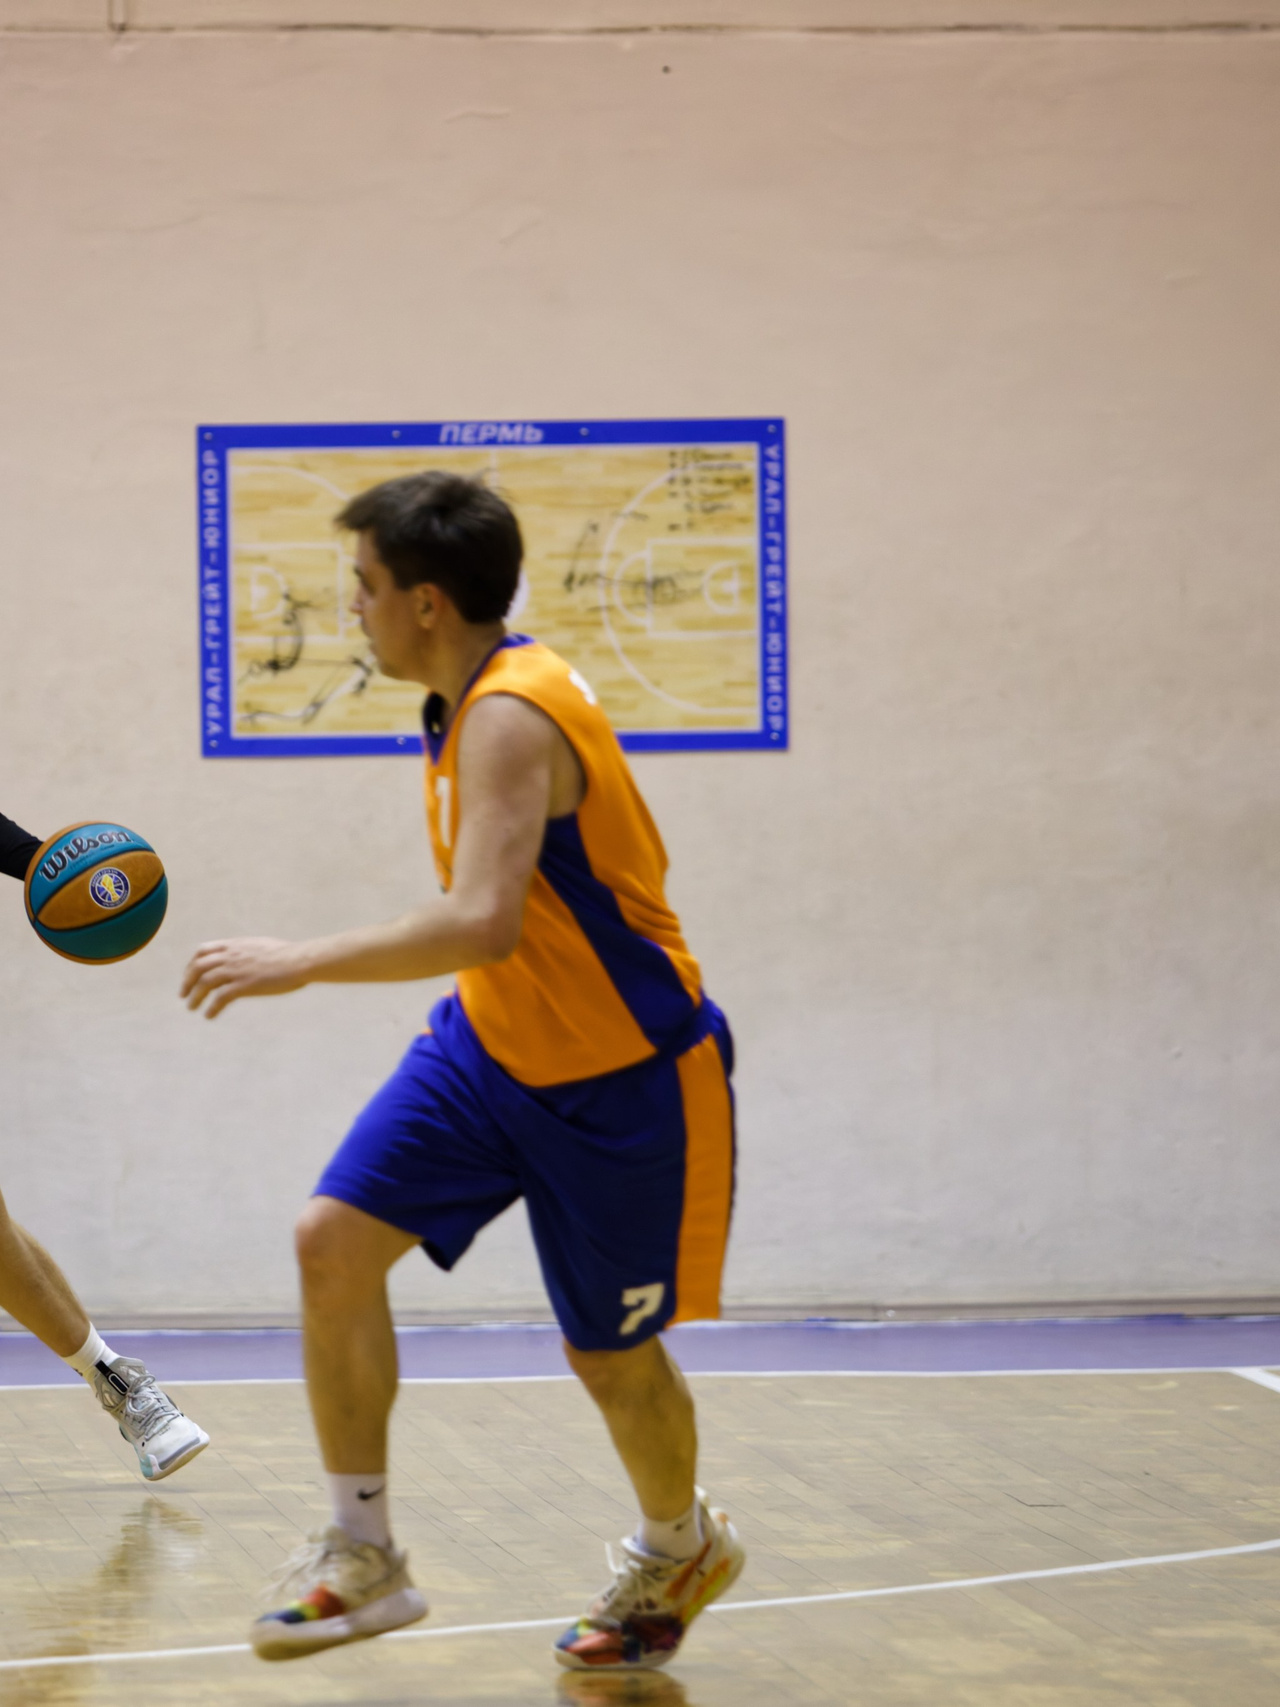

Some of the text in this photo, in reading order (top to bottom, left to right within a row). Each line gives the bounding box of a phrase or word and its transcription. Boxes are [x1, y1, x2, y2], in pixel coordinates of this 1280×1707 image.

[439, 423, 544, 443] ПЕРМЬ
[202, 449, 222, 735] УРАЛ-ГРЕЙТ-ЮНИОР
[764, 445, 784, 730] УРАЛ-ГРЕЙТ-ЮНИОР
[40, 831, 133, 881] Wilson
[620, 1283, 664, 1335] 7
